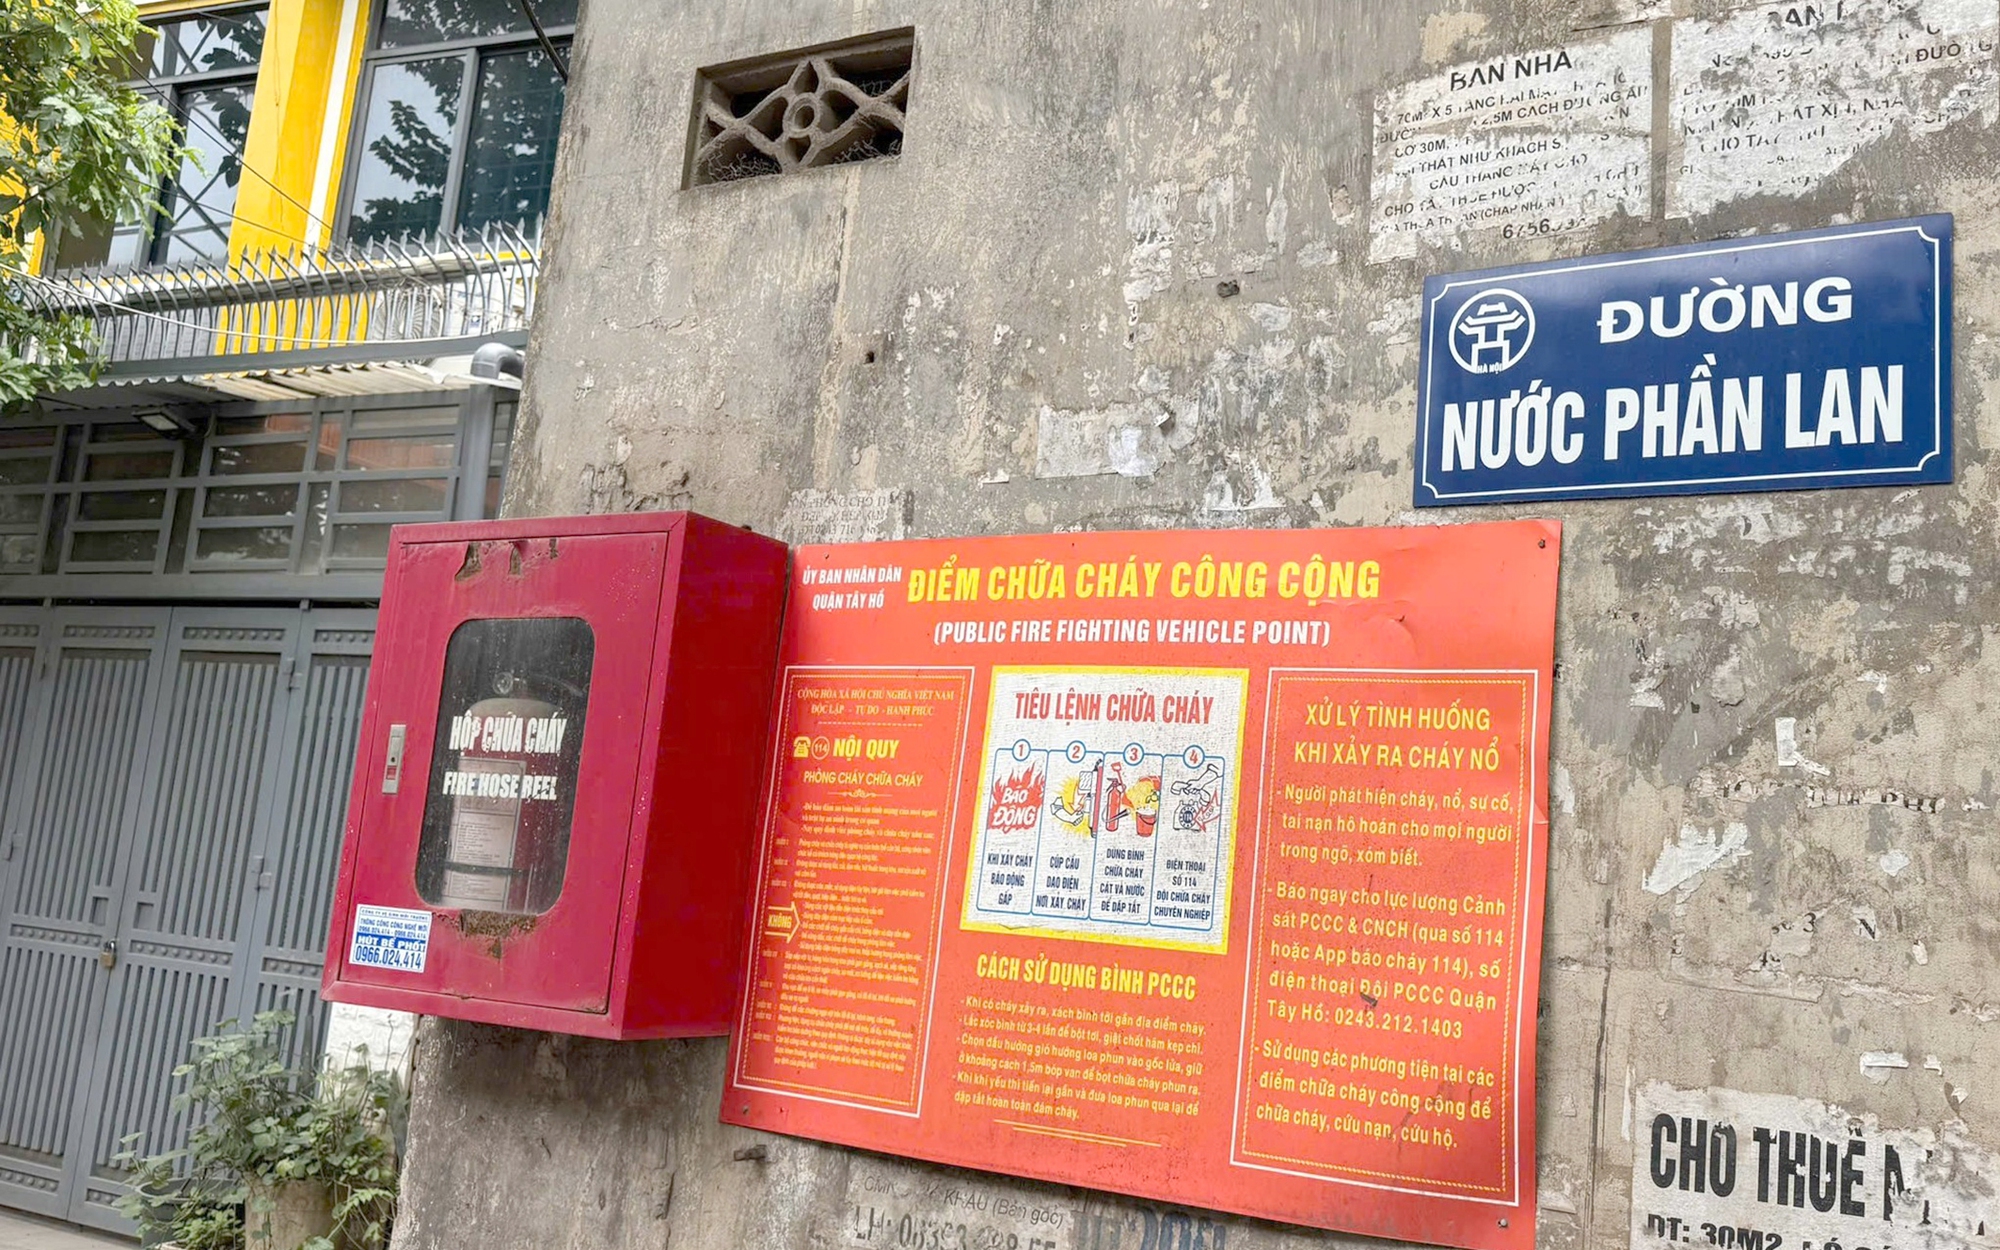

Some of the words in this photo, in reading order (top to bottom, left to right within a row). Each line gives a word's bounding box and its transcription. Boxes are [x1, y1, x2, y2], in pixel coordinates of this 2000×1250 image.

[1597, 276, 1853, 345] ĐƯỜNG
[1441, 379, 1585, 473] NƯỚC
[1603, 353, 1764, 462] PHẦN
[1784, 365, 1904, 450] LAN
[802, 565, 818, 584] ỦY
[818, 569, 842, 584] BAN
[844, 565, 876, 583] NHÂN
[877, 564, 902, 582] DÂN
[908, 554, 980, 602] ĐIỂM
[987, 558, 1065, 600] CHỮA
[1075, 554, 1162, 598] CHÁY
[1170, 554, 1267, 598] CÔNG
[1278, 553, 1380, 606] CỘNG
[812, 590, 844, 612] QUẬN
[846, 590, 867, 608] TÂY
[934, 620, 1006, 645] (PUBLIC
[1010, 620, 1052, 642] FIRE
[1056, 619, 1150, 642] FIGHTING
[1156, 619, 1246, 643] VEHICLE
[1252, 620, 1330, 646] POINT)
[1015, 687, 1051, 719] TIÊU
[1054, 687, 1101, 726] LỆNH
[1106, 687, 1155, 722] CHỮA
[1162, 689, 1214, 724] CHÁY
[1305, 695, 1333, 726] XỬ
[1336, 699, 1361, 726] LÝ
[1365, 700, 1412, 728] TÌNH
[1418, 698, 1490, 730] HUỐNG
[814, 743, 828, 754] 114
[833, 734, 862, 761] NỘI
[866, 739, 899, 760] QUY
[1018, 744, 1024, 757] 1
[1071, 745, 1081, 759] 2
[1129, 748, 1138, 761] 3
[1189, 750, 1199, 764] 4
[1294, 741, 1327, 763] KHI
[1332, 734, 1371, 765] XẢY
[1376, 744, 1402, 766] RA
[1408, 740, 1464, 769] CHÁY
[1470, 735, 1499, 771] NỔ
[443, 771, 478, 795] FIRE
[478, 773, 520, 799] HOSE
[803, 768, 836, 784] PHÒNG
[837, 772, 865, 784] CHÁY
[865, 770, 892, 785] CHỮA
[894, 771, 923, 786] CHÁY
[1002, 784, 1028, 804] BÁO
[1284, 783, 1326, 805] Người
[1329, 786, 1362, 806] phát
[1365, 787, 1396, 808] hiện
[1400, 790, 1438, 811] cháy,
[1442, 787, 1465, 811] nổ,
[1469, 795, 1488, 810] sự
[1490, 792, 1513, 814] cố,
[992, 804, 1037, 833] ĐỘNG
[1282, 813, 1301, 829] tai
[1305, 817, 1332, 834] nạn
[1336, 815, 1355, 832] hô
[1359, 817, 1396, 834] hoán
[1401, 819, 1429, 837] cho
[1433, 821, 1462, 841] mọi
[1466, 823, 1512, 844] người
[1280, 841, 1317, 863] trong
[1322, 844, 1352, 865] ngõ,
[1356, 846, 1386, 863] xóm
[1390, 846, 1422, 866] biết.
[1184, 876, 1197, 887] 114
[1154, 905, 1182, 918] CHUYÊN
[1184, 907, 1210, 921] NGHIỆP
[1276, 881, 1306, 900] Báo
[1310, 887, 1347, 907] ngay
[1351, 887, 1380, 905] cho
[1384, 889, 1408, 910] lực
[1412, 891, 1457, 916] lượng
[1462, 894, 1505, 915] Cảnh
[358, 936, 379, 946] HÚT
[1272, 911, 1296, 928] sát
[1299, 912, 1343, 933] PCCC
[1347, 916, 1357, 934] &
[1362, 917, 1408, 938] CNCH
[1412, 922, 1447, 944] (qua
[1452, 924, 1472, 944] số
[1476, 928, 1503, 947] 114
[355, 945, 422, 969] 0966.024.414
[1270, 940, 1309, 962] hoặc
[1313, 944, 1346, 967] App
[1351, 947, 1382, 966] báo
[1385, 951, 1427, 975] cháy
[1432, 955, 1473, 979] 114),
[1479, 958, 1501, 978] số
[976, 951, 1020, 980] CÁCH
[1023, 953, 1047, 983] SỬ
[1049, 962, 1096, 991] DỤNG
[1100, 963, 1143, 994] BÌNH
[1147, 972, 1196, 1000] PCCC
[1269, 970, 1305, 991] điện
[1310, 974, 1354, 997] thoại
[1393, 982, 1444, 1005] PCCC
[1449, 988, 1496, 1012] Quận
[1267, 999, 1296, 1023] Tây
[1334, 1007, 1462, 1038] 0243.212.1403
[1262, 1039, 1282, 1058] Sử
[1283, 1043, 1319, 1068] dụng
[1322, 1048, 1347, 1067] các
[1350, 1052, 1406, 1079] phương
[1410, 1059, 1438, 1081] tiện
[1443, 1063, 1463, 1082] tại
[1466, 1066, 1494, 1087] các
[1259, 1069, 1295, 1091] điểm
[1299, 1077, 1335, 1097] chữa
[1339, 1082, 1376, 1107] cháy
[1380, 1087, 1420, 1114] công
[1424, 1094, 1465, 1120] cộng
[1470, 1096, 1491, 1119] để
[1256, 1102, 1290, 1123] chữa
[1293, 1108, 1330, 1132] cháy,
[1334, 1113, 1360, 1133] cứu
[1400, 1123, 1428, 1144] cứu
[1433, 1126, 1457, 1150] hộ.
[1650, 1113, 1737, 1198] CHO
[1753, 1126, 1866, 1218] THUÊ
